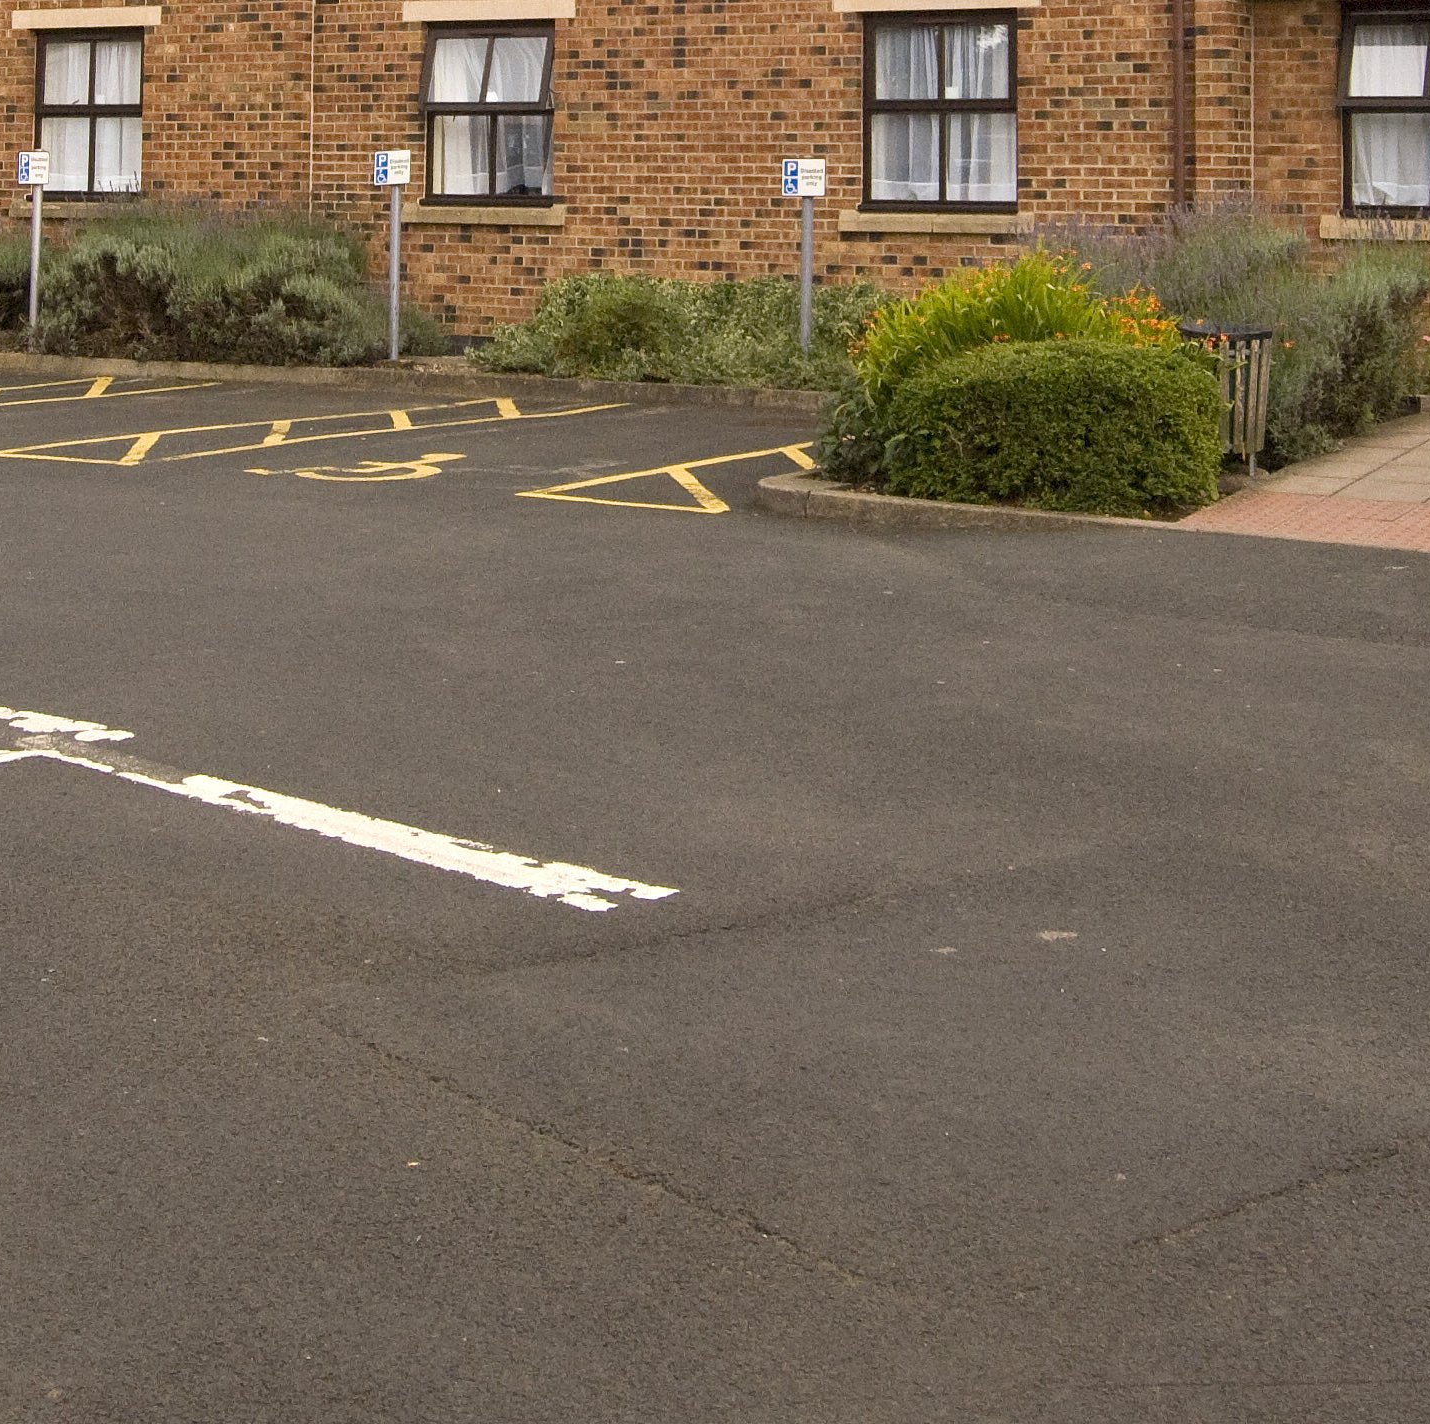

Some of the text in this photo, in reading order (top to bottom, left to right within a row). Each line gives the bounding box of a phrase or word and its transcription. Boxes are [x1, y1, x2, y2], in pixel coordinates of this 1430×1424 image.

[21, 154, 28, 167] P
[378, 154, 386, 167] P
[787, 162, 797, 175] P
